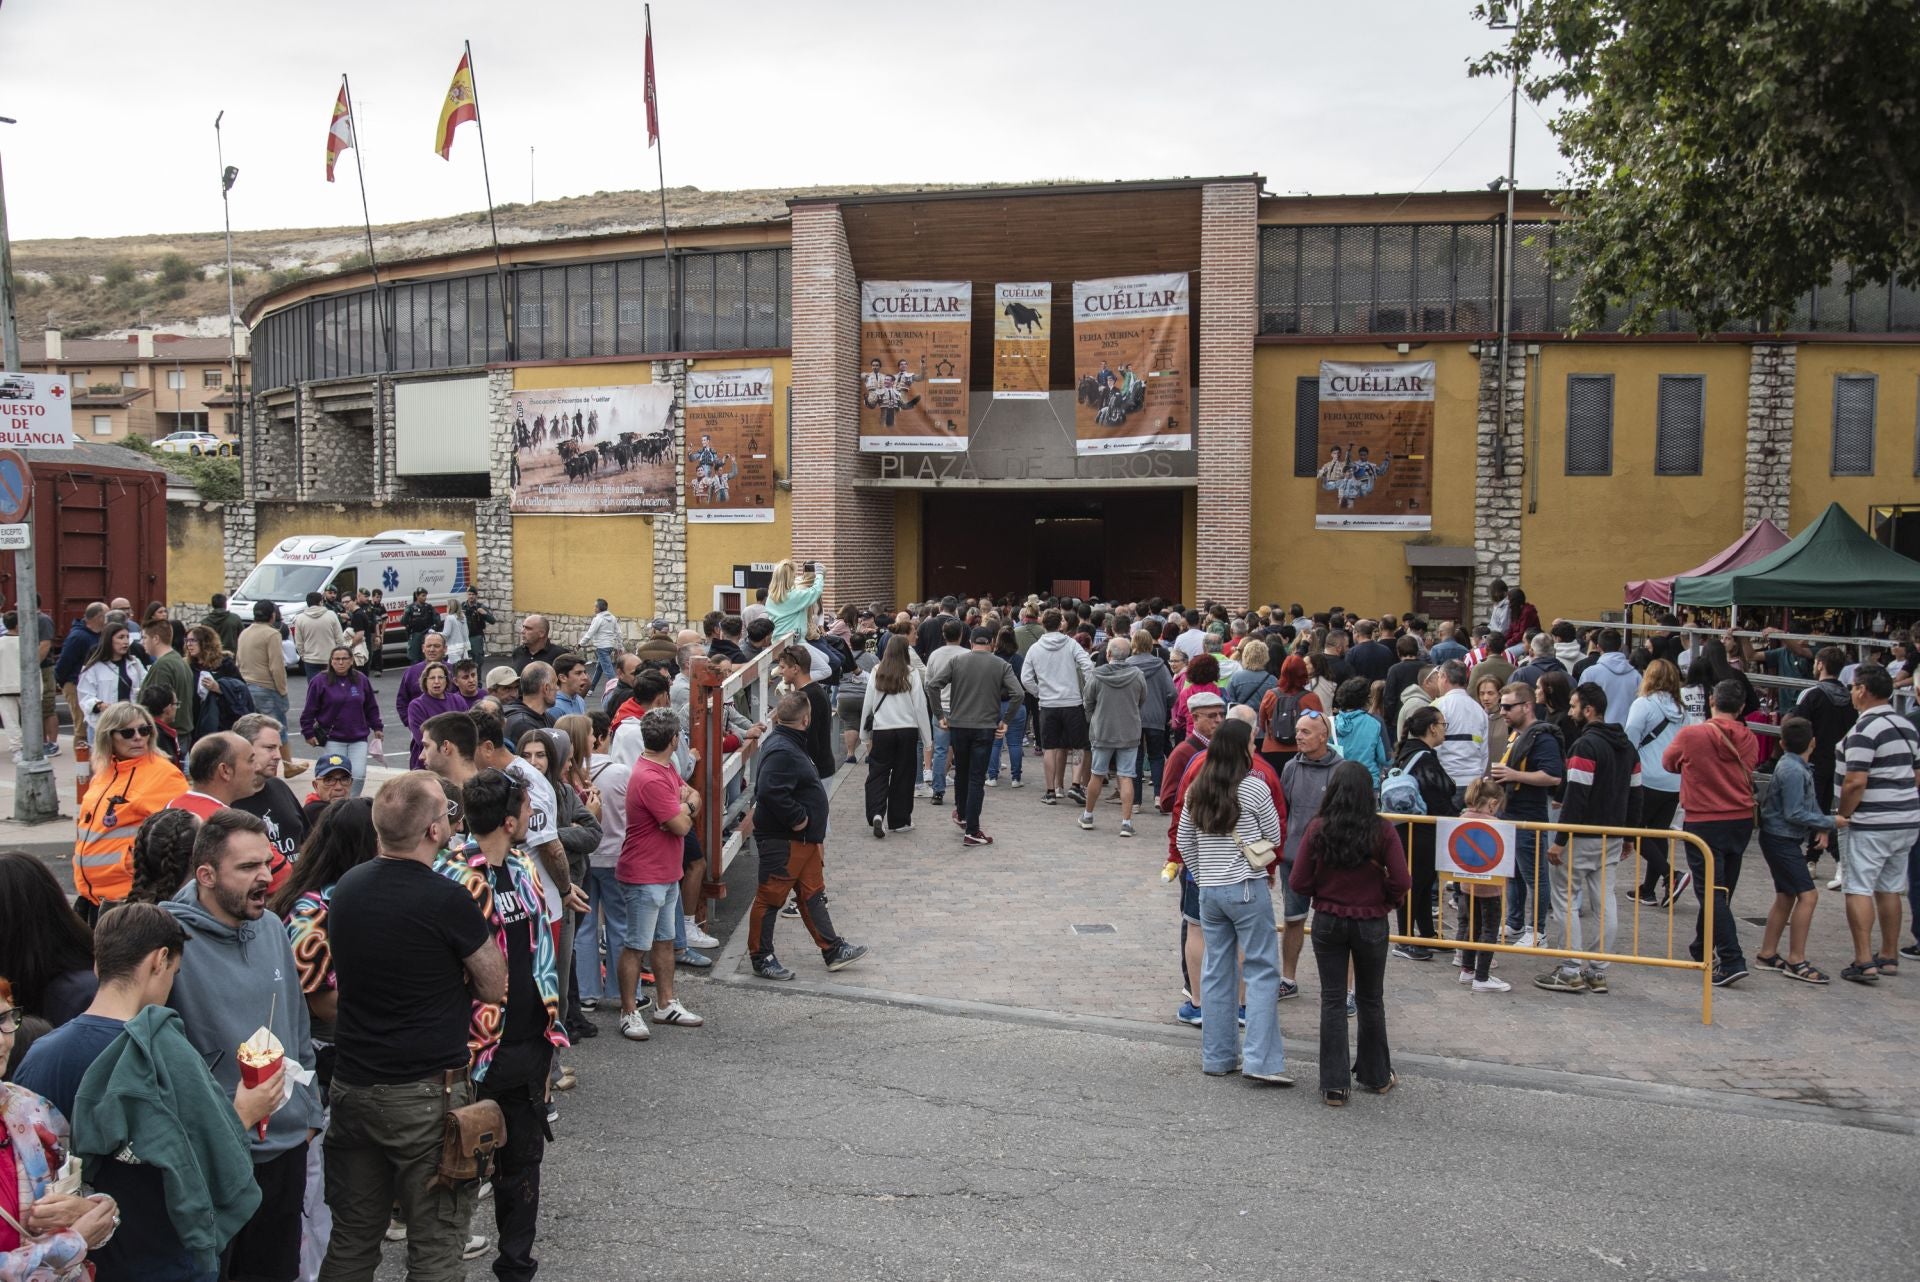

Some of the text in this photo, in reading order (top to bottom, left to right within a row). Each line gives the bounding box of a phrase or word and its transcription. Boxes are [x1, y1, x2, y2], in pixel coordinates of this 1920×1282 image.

[1003, 288, 1043, 298] CUÉLLAR
[872, 293, 960, 313] CUÉLLAR
[1084, 290, 1178, 312] CUÉLLAR
[866, 331, 923, 339] FERIA TAURINA
[1079, 331, 1140, 342] FERIA TAURINA
[1102, 341, 1119, 349] 2025
[1330, 373, 1424, 392] CUÉLLAR
[694, 381, 763, 399] CUÉLLAR
[12, 418, 30, 429] DE
[881, 453, 1173, 479] PLAZA DE TOROS
[0, 537, 25, 545] TURISMOS
[380, 550, 405, 558] SOPORTE
[421, 549, 447, 557] AVANZADO
